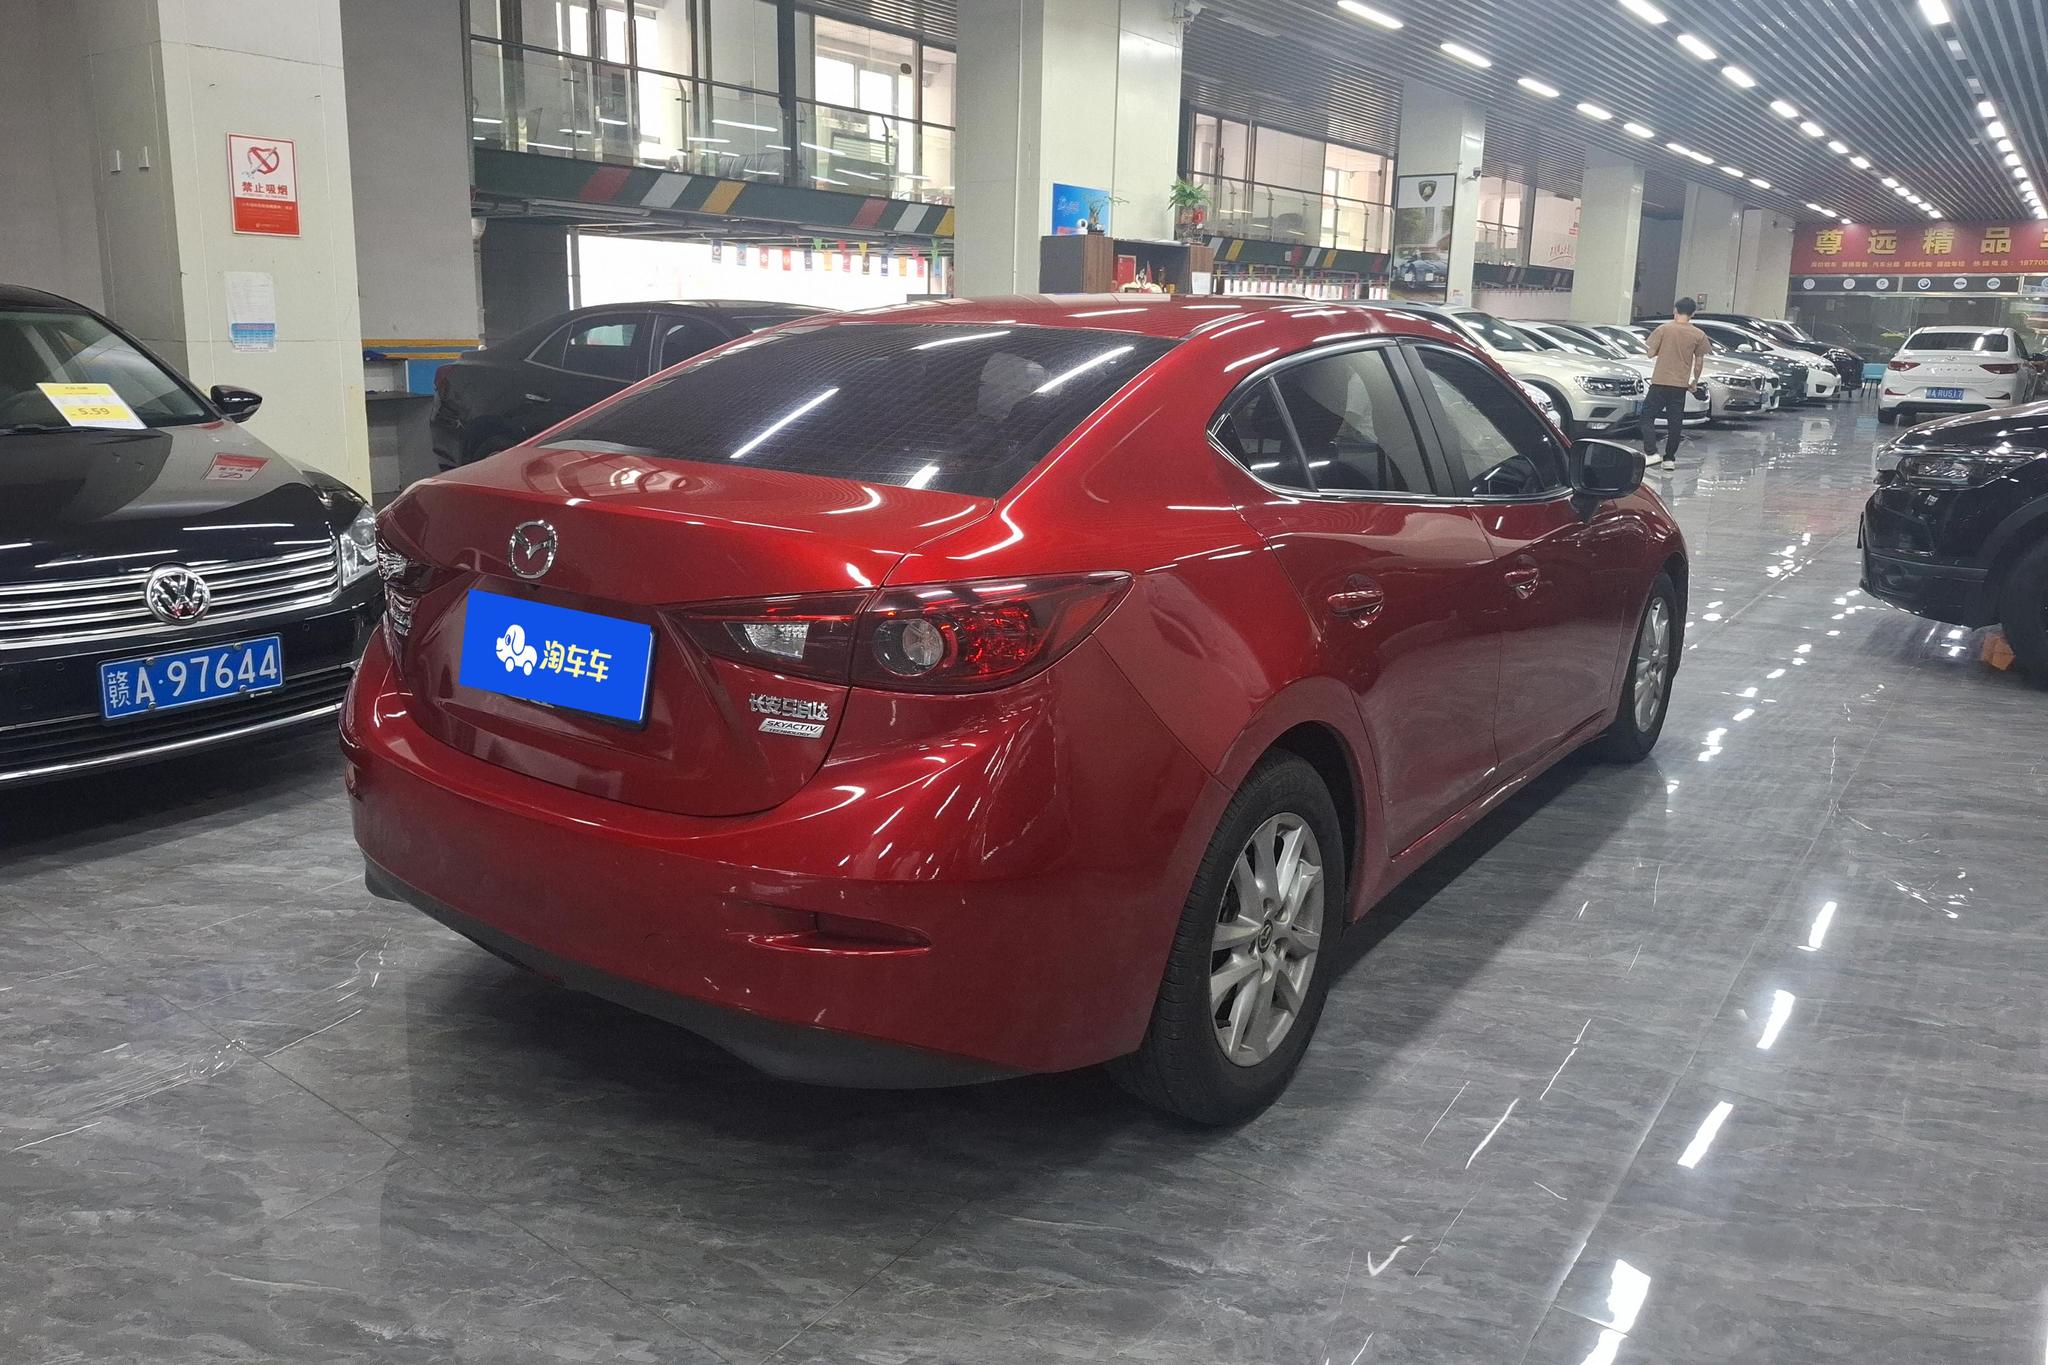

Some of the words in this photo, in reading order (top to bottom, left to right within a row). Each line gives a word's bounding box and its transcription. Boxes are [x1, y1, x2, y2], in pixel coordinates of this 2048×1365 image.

[241, 181, 288, 196] 禁止吸烟
[77, 407, 110, 415] 5.59
[107, 645, 278, 708] 赣A·97644
[749, 692, 829, 721] 长安马自达
[766, 720, 818, 732] SKYACTIV
